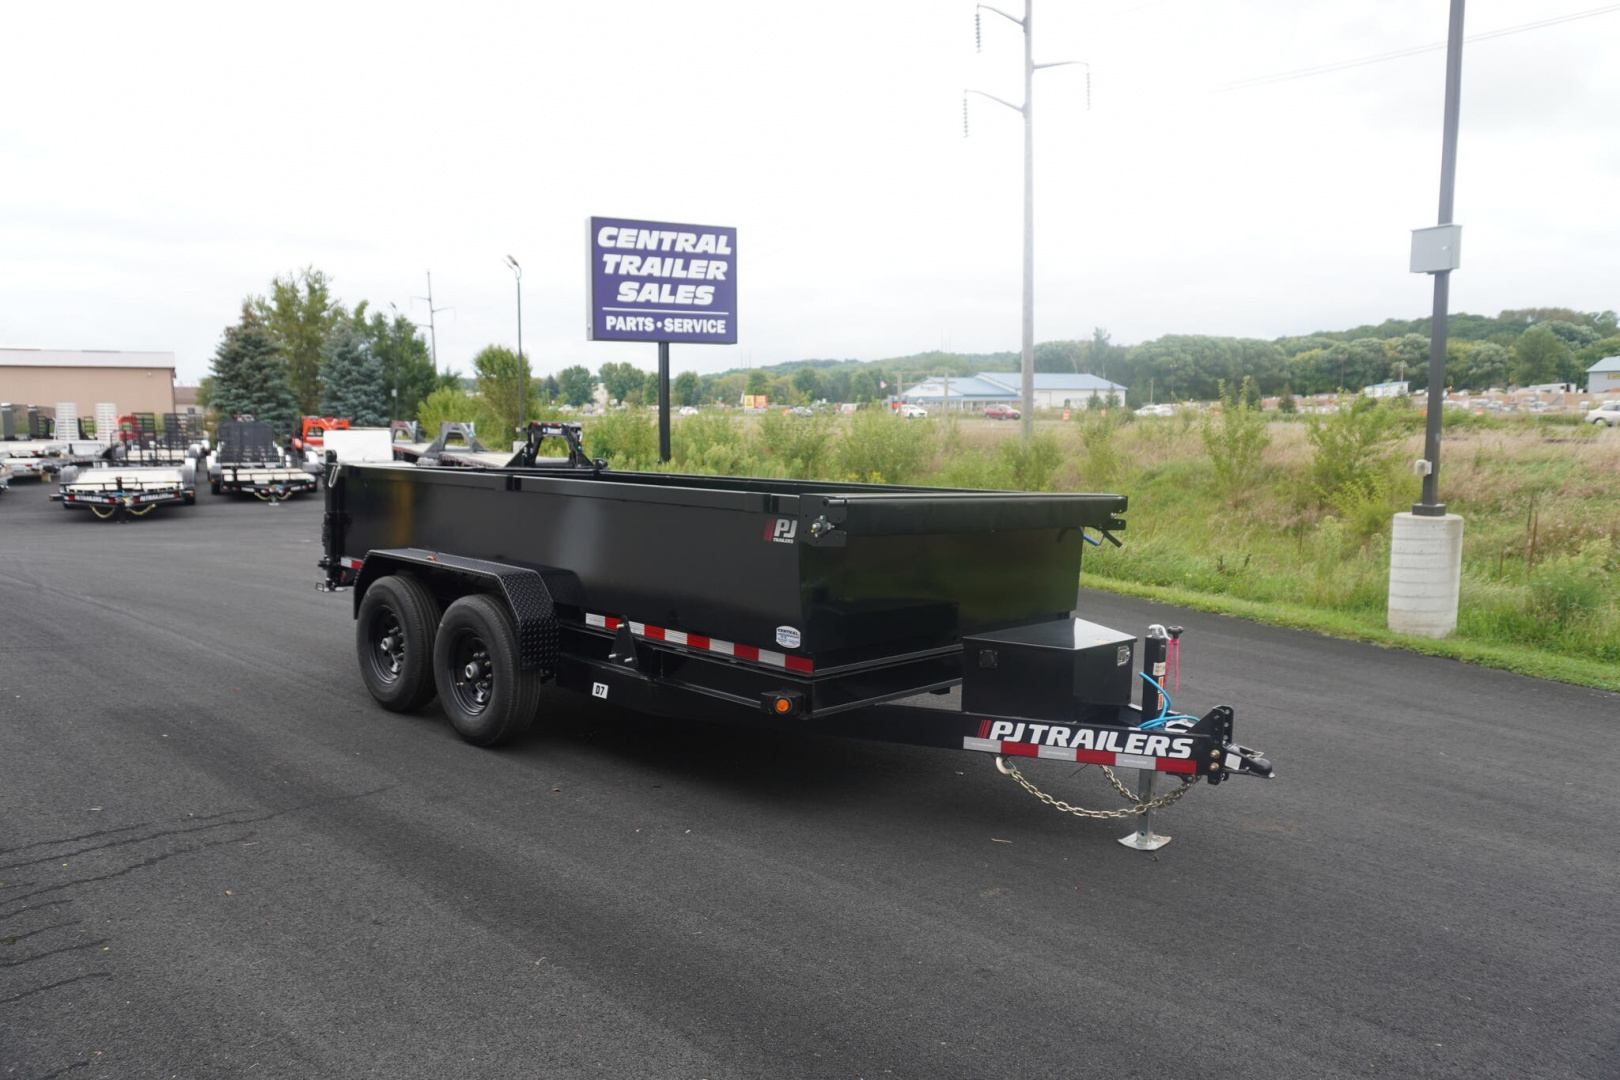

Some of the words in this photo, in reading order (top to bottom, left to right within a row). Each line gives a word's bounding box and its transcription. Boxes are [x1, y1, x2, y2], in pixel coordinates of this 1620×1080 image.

[597, 226, 732, 255] CENTRAL
[602, 253, 728, 280] TRAILER
[616, 281, 715, 306] SALES
[605, 315, 655, 332] PARTS
[663, 317, 727, 334] SERVICE
[774, 518, 798, 538] PJ
[989, 720, 1025, 743] PJ
[1029, 725, 1194, 759] TRAILERS
